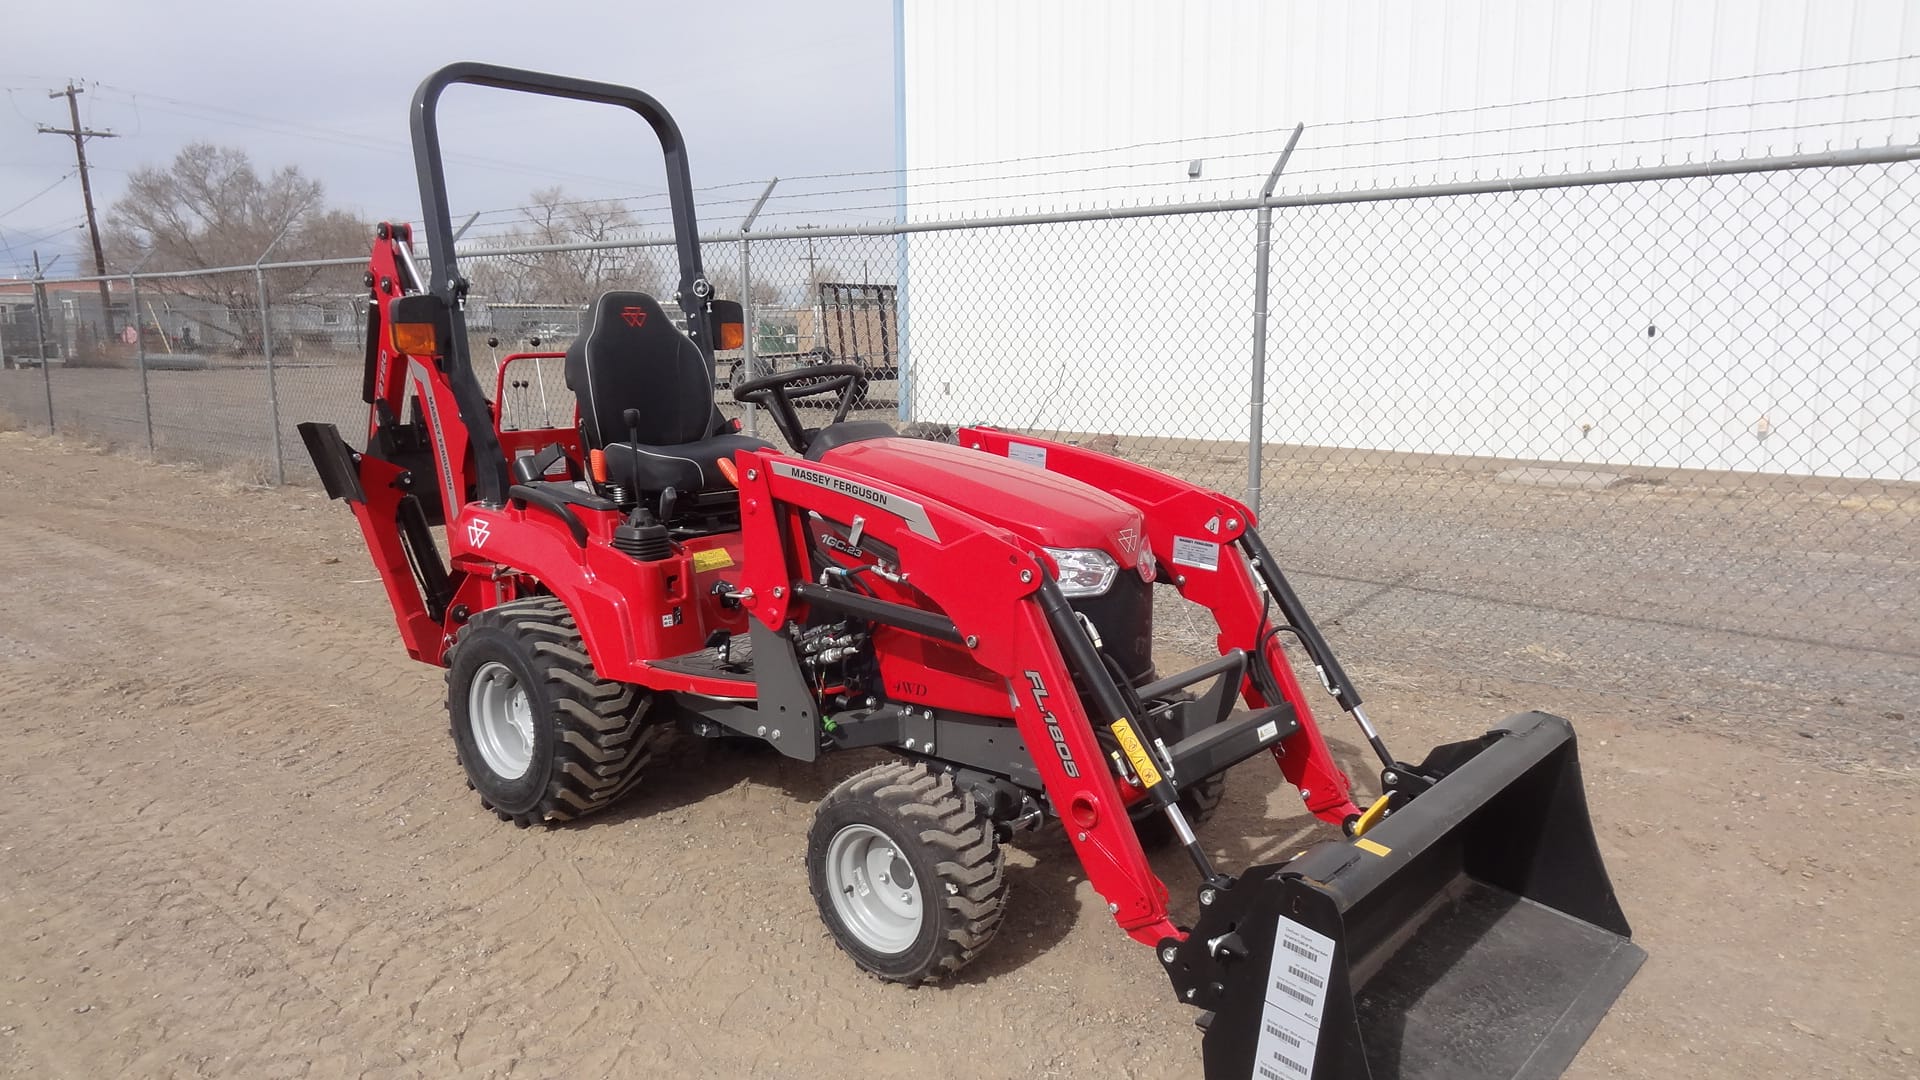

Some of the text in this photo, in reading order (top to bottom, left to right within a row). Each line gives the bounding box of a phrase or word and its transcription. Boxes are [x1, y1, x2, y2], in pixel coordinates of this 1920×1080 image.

[428, 396, 453, 490] MASSEY FERGUSON
[791, 467, 887, 505] MASSEY FERGUSON
[821, 533, 863, 558] 1GC.23
[892, 680, 928, 697] 4WD
[1024, 670, 1080, 778] FL.1805
